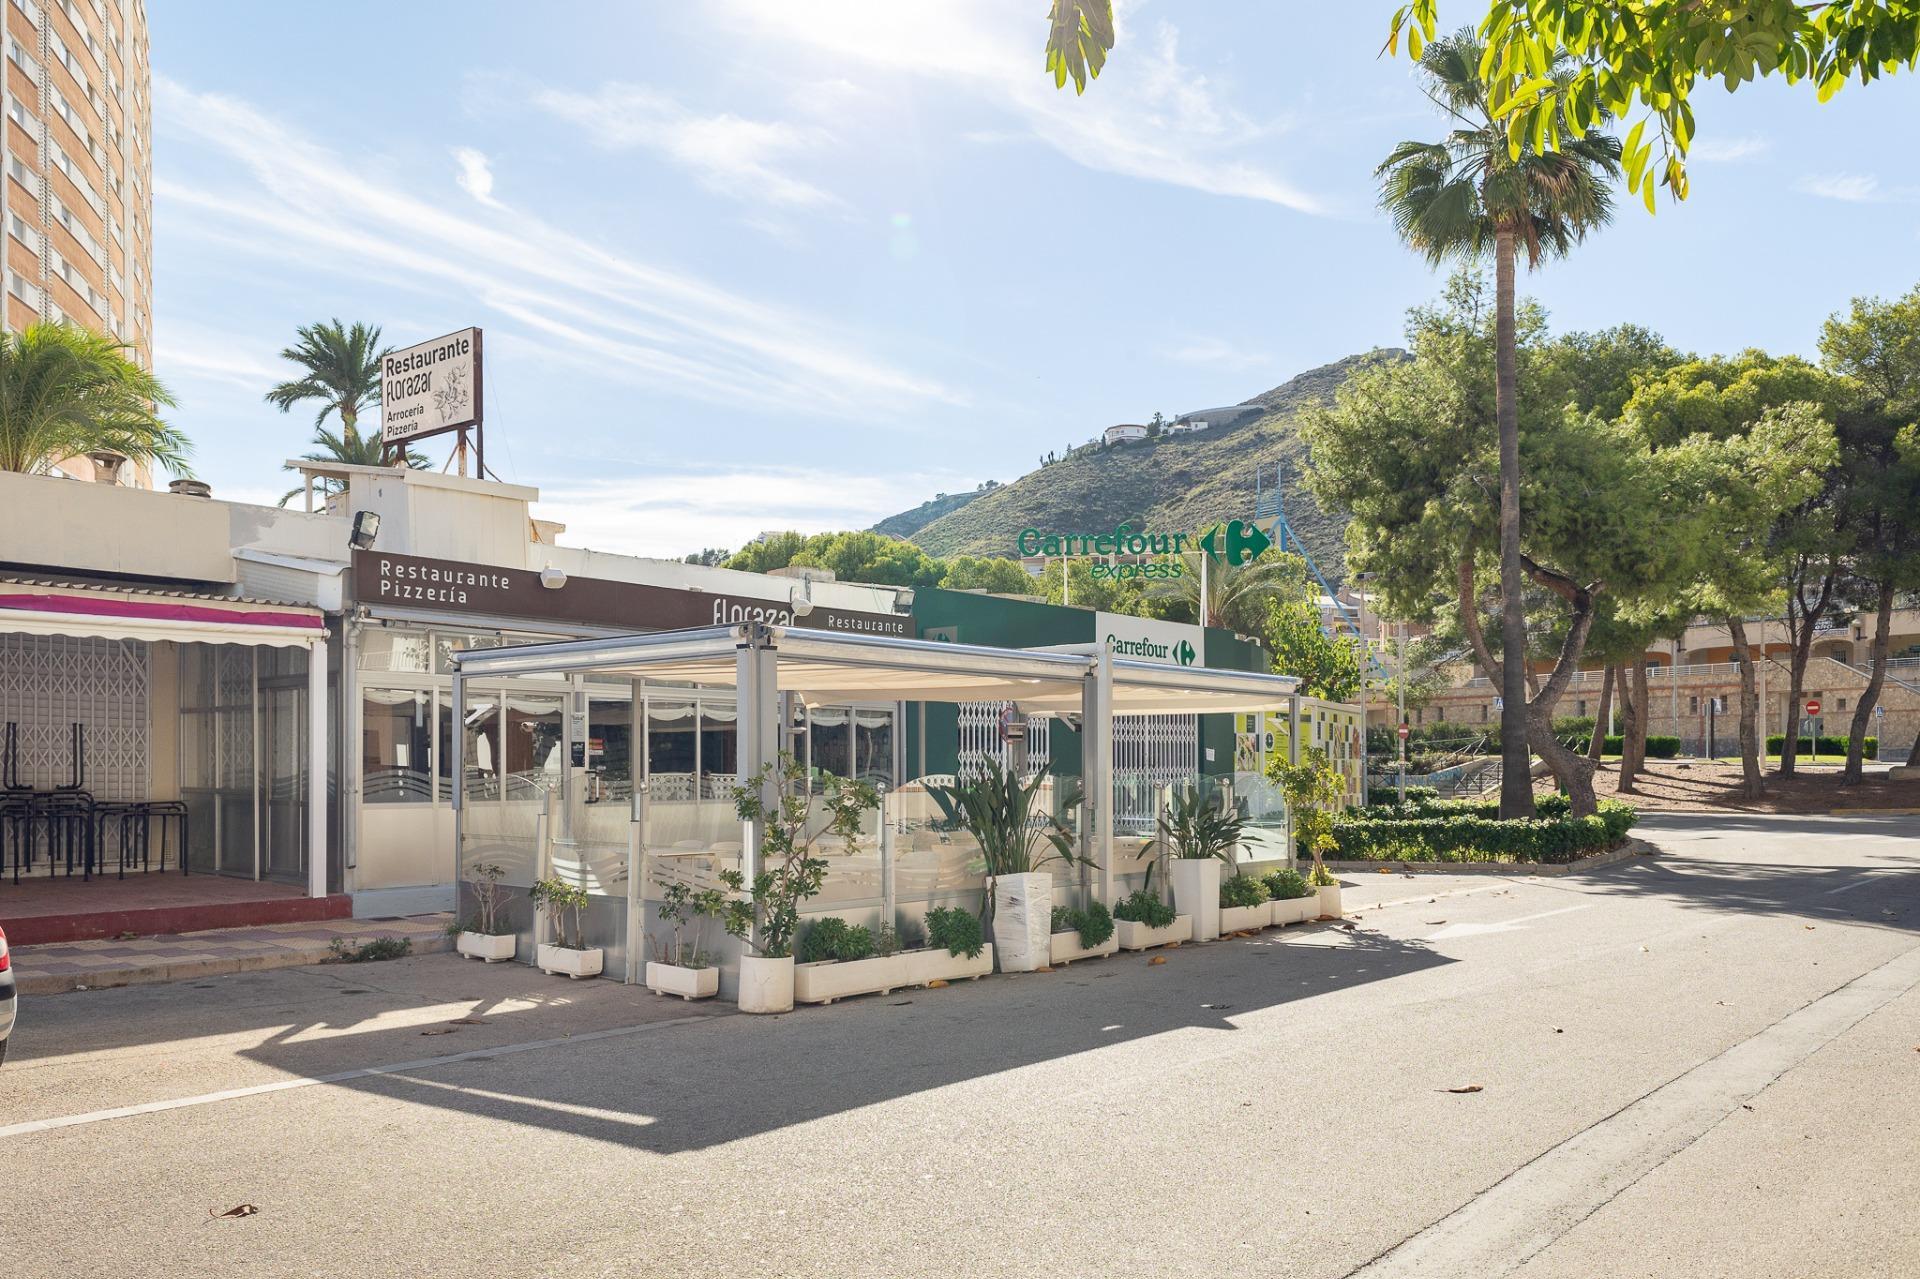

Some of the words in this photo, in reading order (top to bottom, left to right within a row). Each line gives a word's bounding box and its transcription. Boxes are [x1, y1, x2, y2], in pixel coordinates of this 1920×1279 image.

[386, 338, 469, 377] Restaurante
[386, 371, 432, 407] florazar
[387, 403, 424, 423] Arrocería
[1018, 525, 1187, 557] Carrefour
[380, 560, 510, 589] Restaurante
[1091, 562, 1183, 583] express
[380, 580, 467, 603] Pizzería
[828, 615, 904, 633] Restaurante
